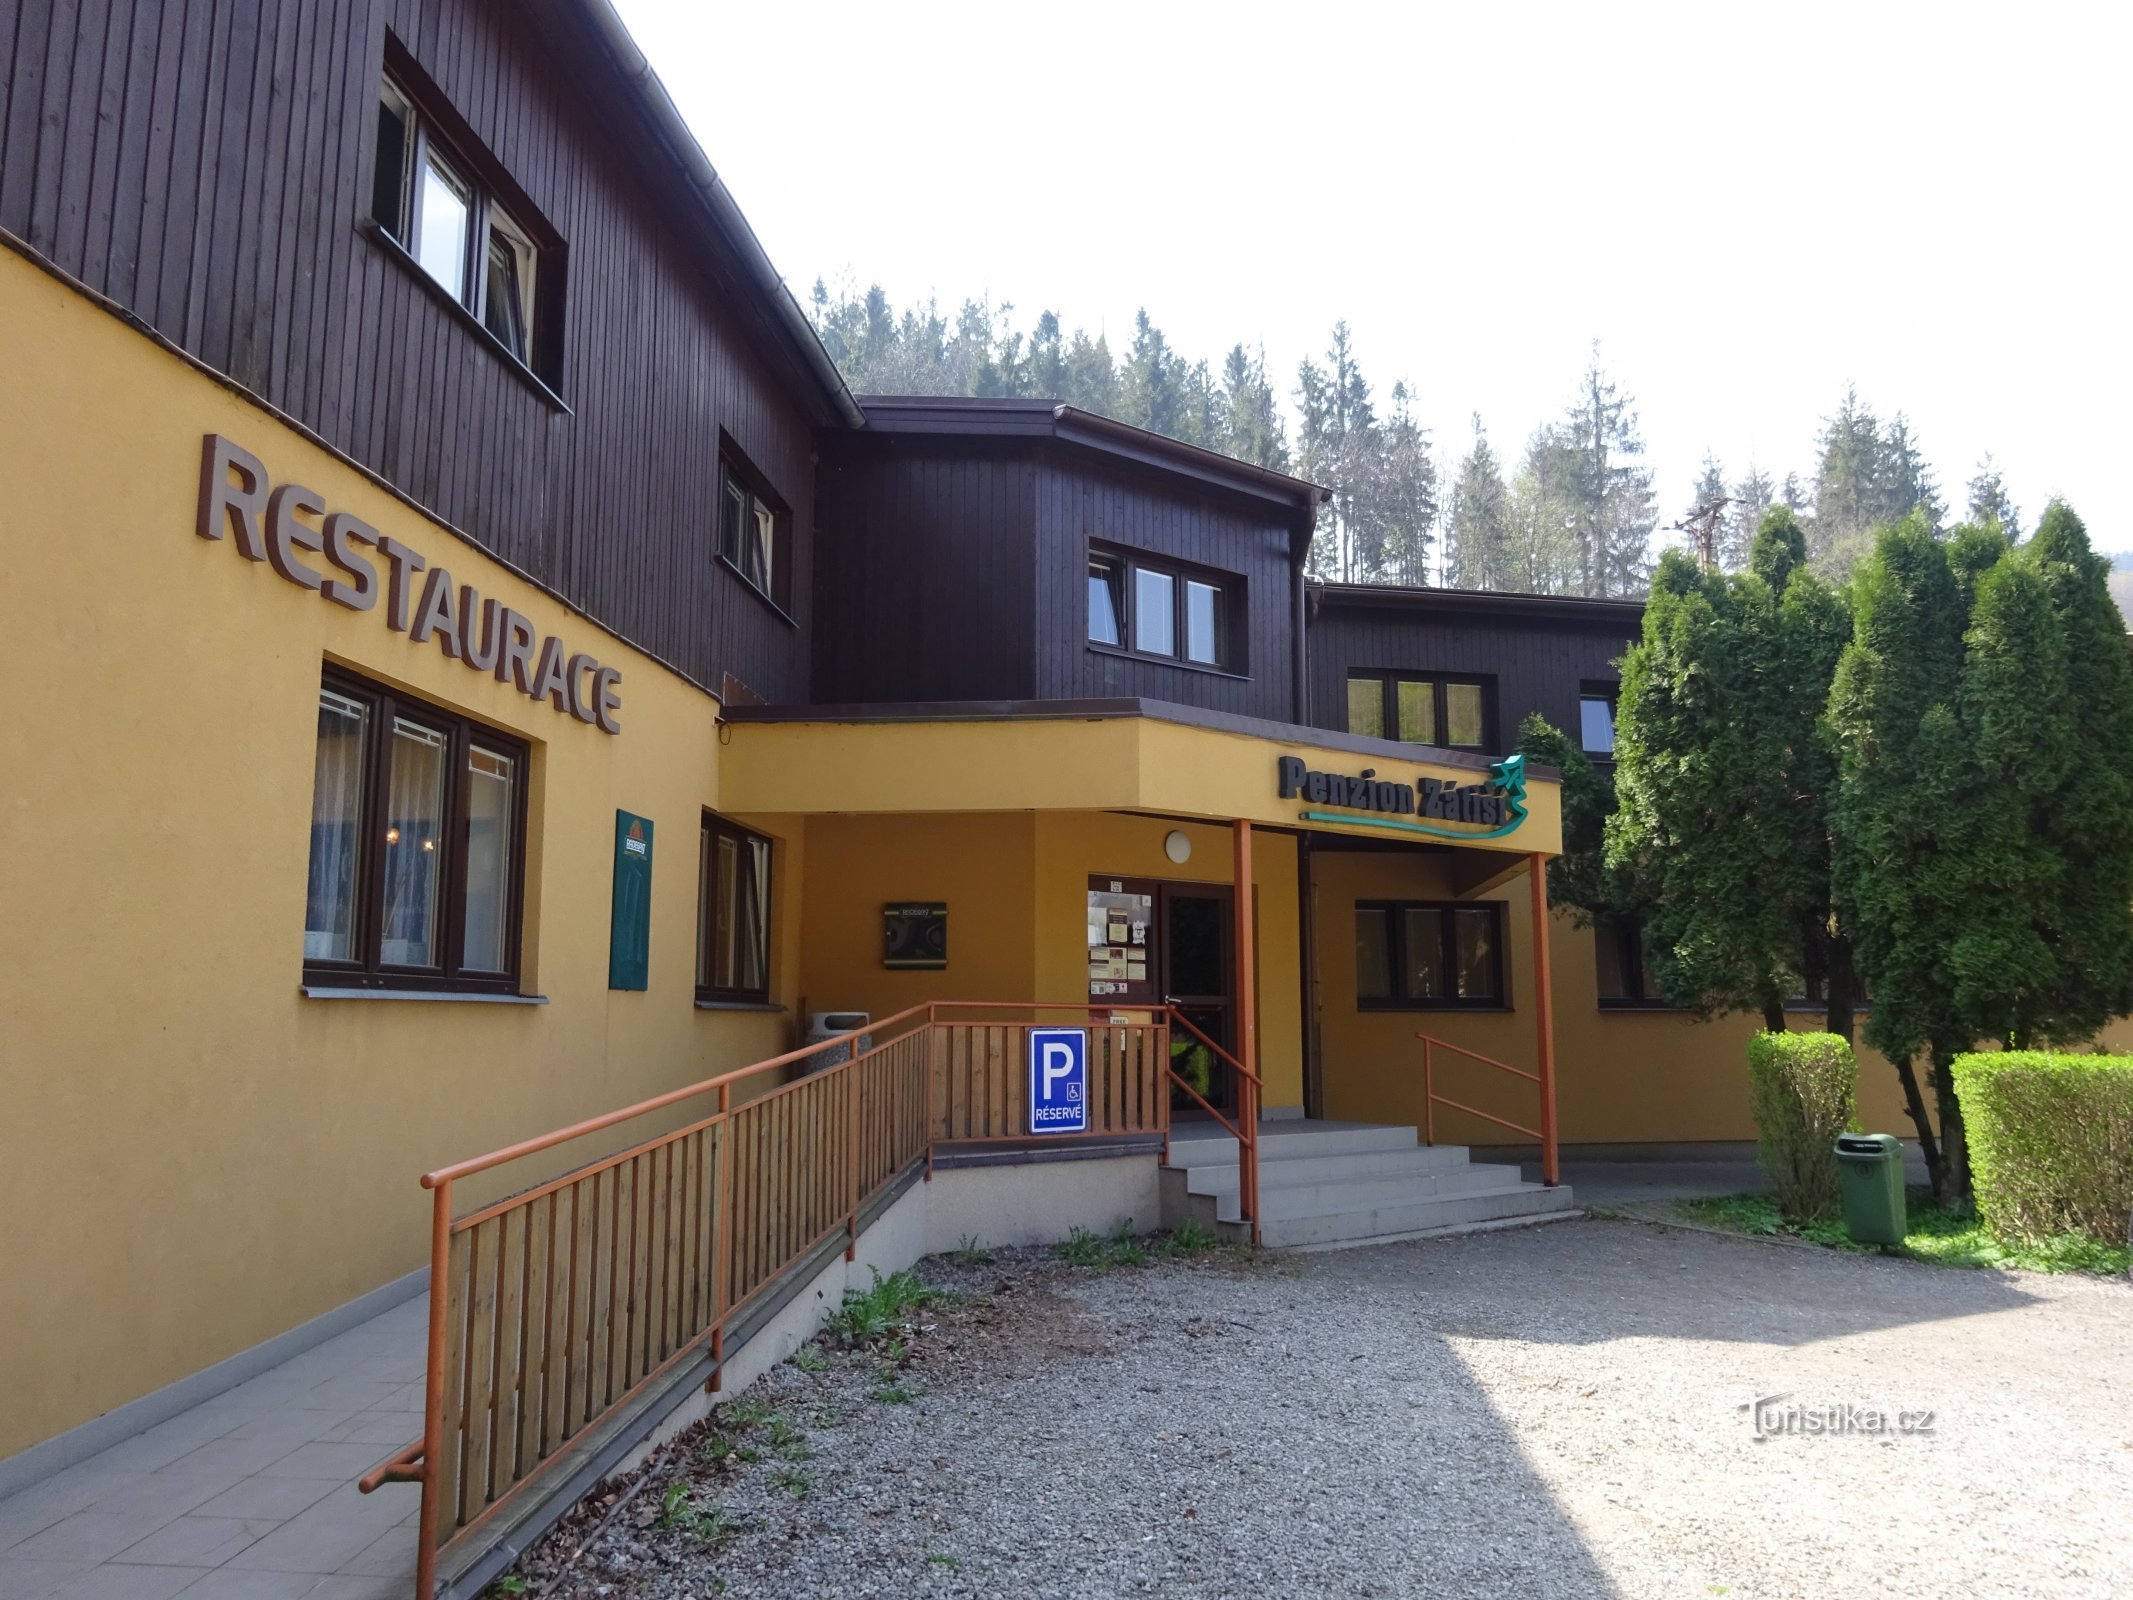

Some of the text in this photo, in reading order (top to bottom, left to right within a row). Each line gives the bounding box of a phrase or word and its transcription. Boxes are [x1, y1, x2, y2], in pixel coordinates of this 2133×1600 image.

[196, 434, 622, 735] RESTAURACE
[1278, 756, 1415, 815] Penzion
[1043, 1042, 1075, 1100] P
[1035, 1103, 1082, 1121] RÉSERVÉ
